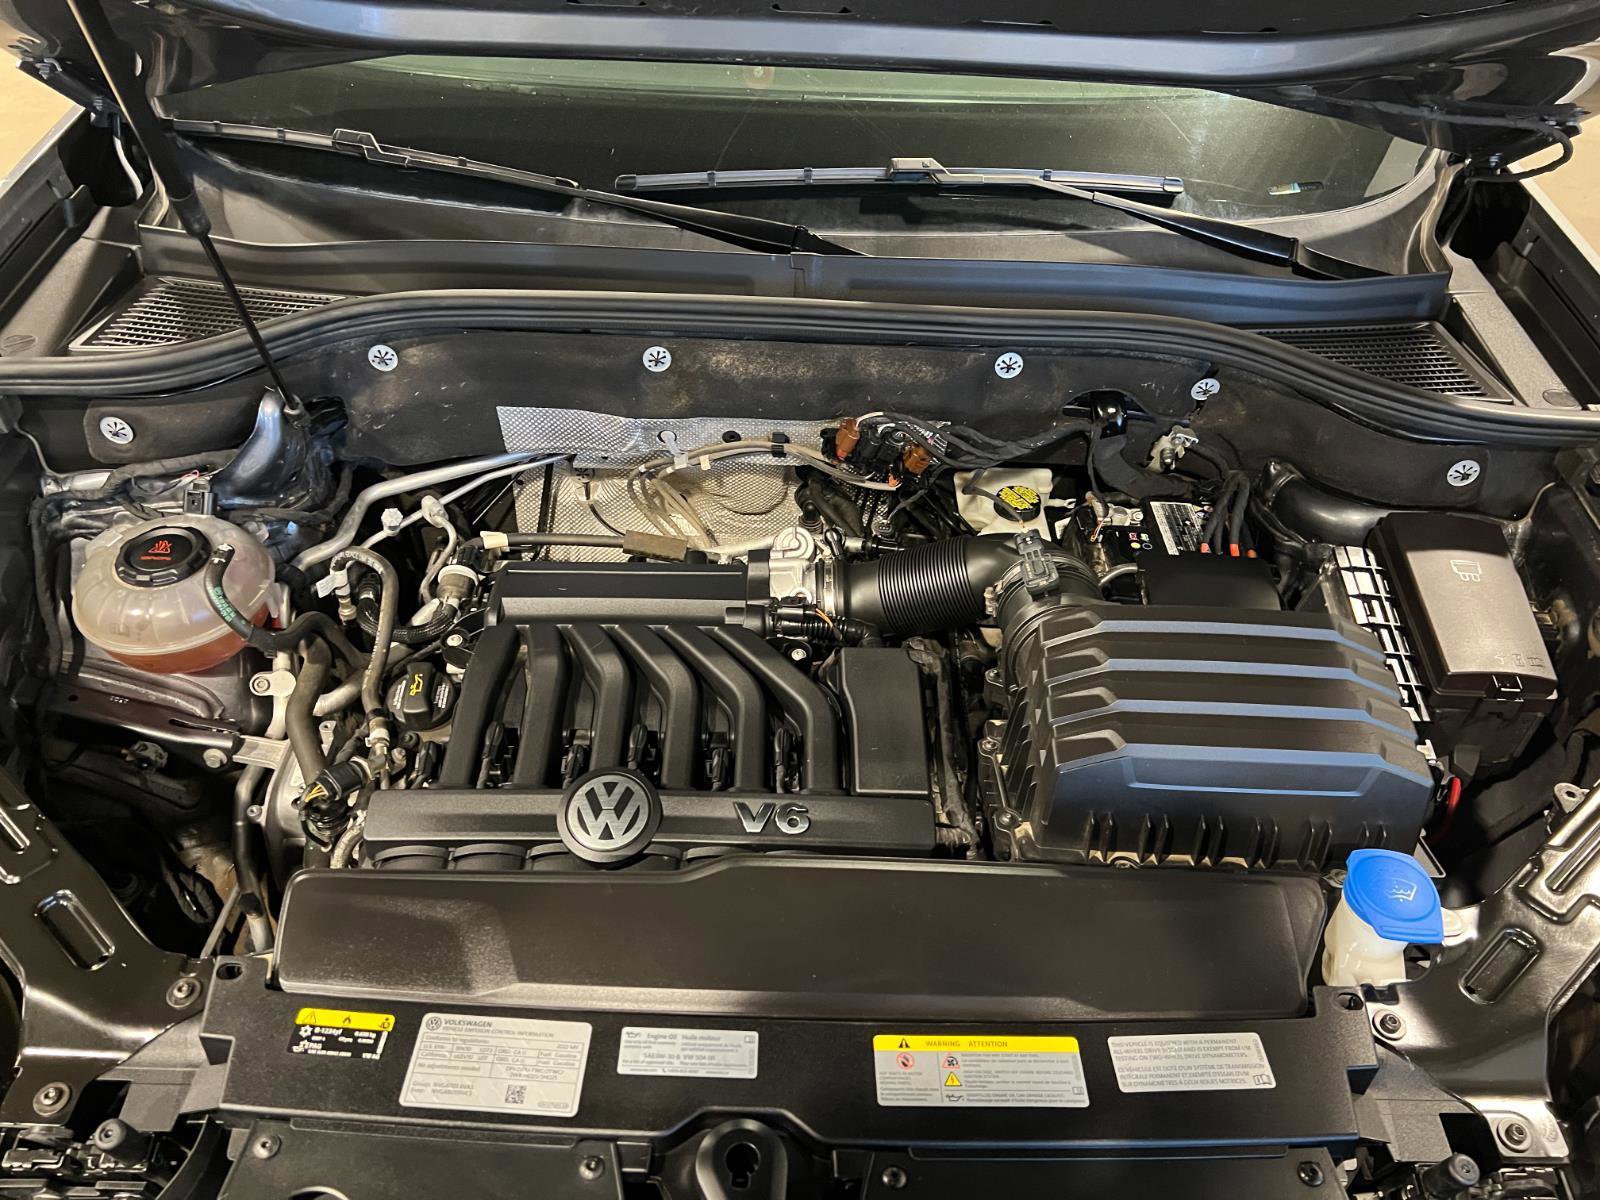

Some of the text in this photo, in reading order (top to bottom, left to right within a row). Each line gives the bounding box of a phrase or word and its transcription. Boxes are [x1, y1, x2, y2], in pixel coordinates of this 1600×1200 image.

[733, 801, 811, 836] V6
[444, 1019, 492, 1028] VOLKSWAGEN
[925, 1040, 961, 1048] WARNING
[969, 1040, 1008, 1048] ATTENTION
